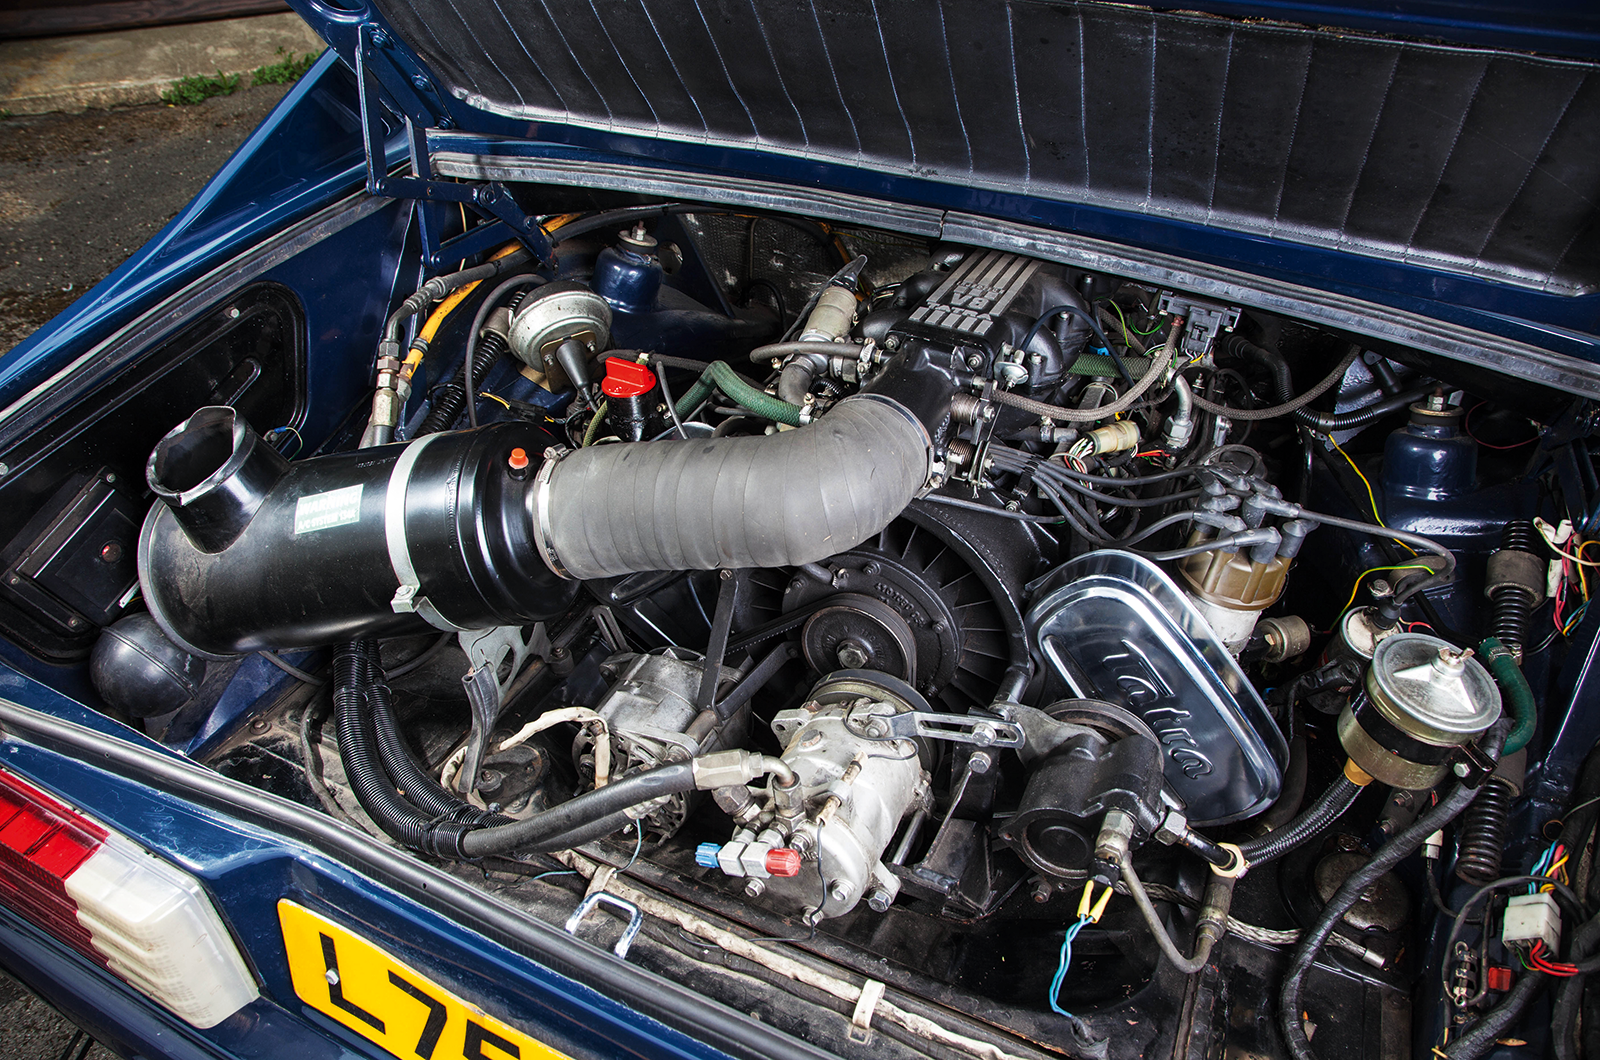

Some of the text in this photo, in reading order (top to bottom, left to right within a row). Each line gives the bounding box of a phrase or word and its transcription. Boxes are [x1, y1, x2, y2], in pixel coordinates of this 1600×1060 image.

[927, 302, 991, 321] TATRA
[951, 292, 989, 310] V8
[299, 491, 358, 516] WARNING
[1102, 638, 1214, 780] Tatra
